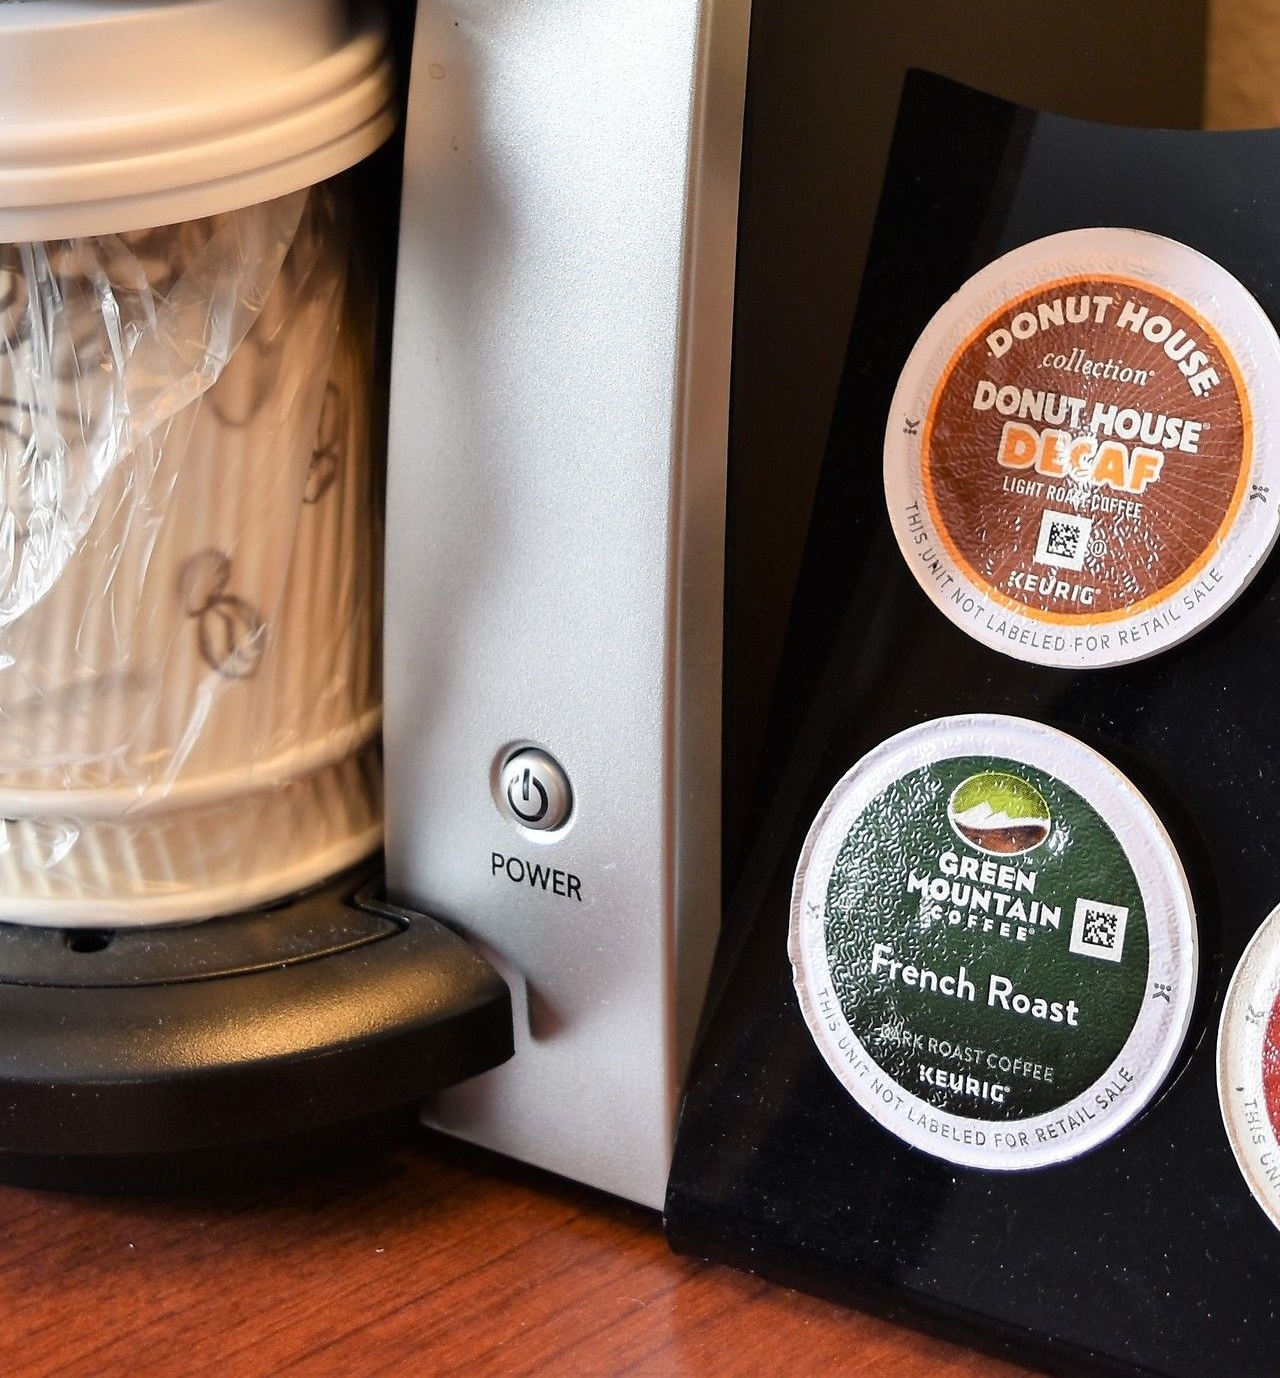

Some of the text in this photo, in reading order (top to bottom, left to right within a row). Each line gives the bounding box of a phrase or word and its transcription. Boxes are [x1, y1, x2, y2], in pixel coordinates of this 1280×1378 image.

[985, 295, 1220, 398] DONUT HOUSE
[1040, 348, 1149, 386] collection
[972, 380, 1203, 453] DONUT HOUSE
[999, 420, 1165, 495] DECAF
[1003, 475, 1044, 498] LIGHT
[1091, 494, 1144, 519] COFFEE
[905, 501, 1223, 652] THIS UNIT NOT LABELED FOR RETAIL SALE
[1008, 570, 1096, 605] KEURIG
[491, 851, 583, 902] POWER
[938, 851, 1037, 895] GREEN
[906, 869, 1062, 930] MOUNTAIN
[930, 905, 1028, 942] COFFEE
[870, 942, 1079, 1027] French Roast
[817, 988, 1134, 1148] THIS UNIT NOT LABELED FOR RETAIL SALE
[919, 1064, 1005, 1103] KEURIG
[928, 1037, 987, 1064] ROAST
[987, 1053, 1054, 1084] COFFEE
[1244, 1097, 1266, 1145] THIS
